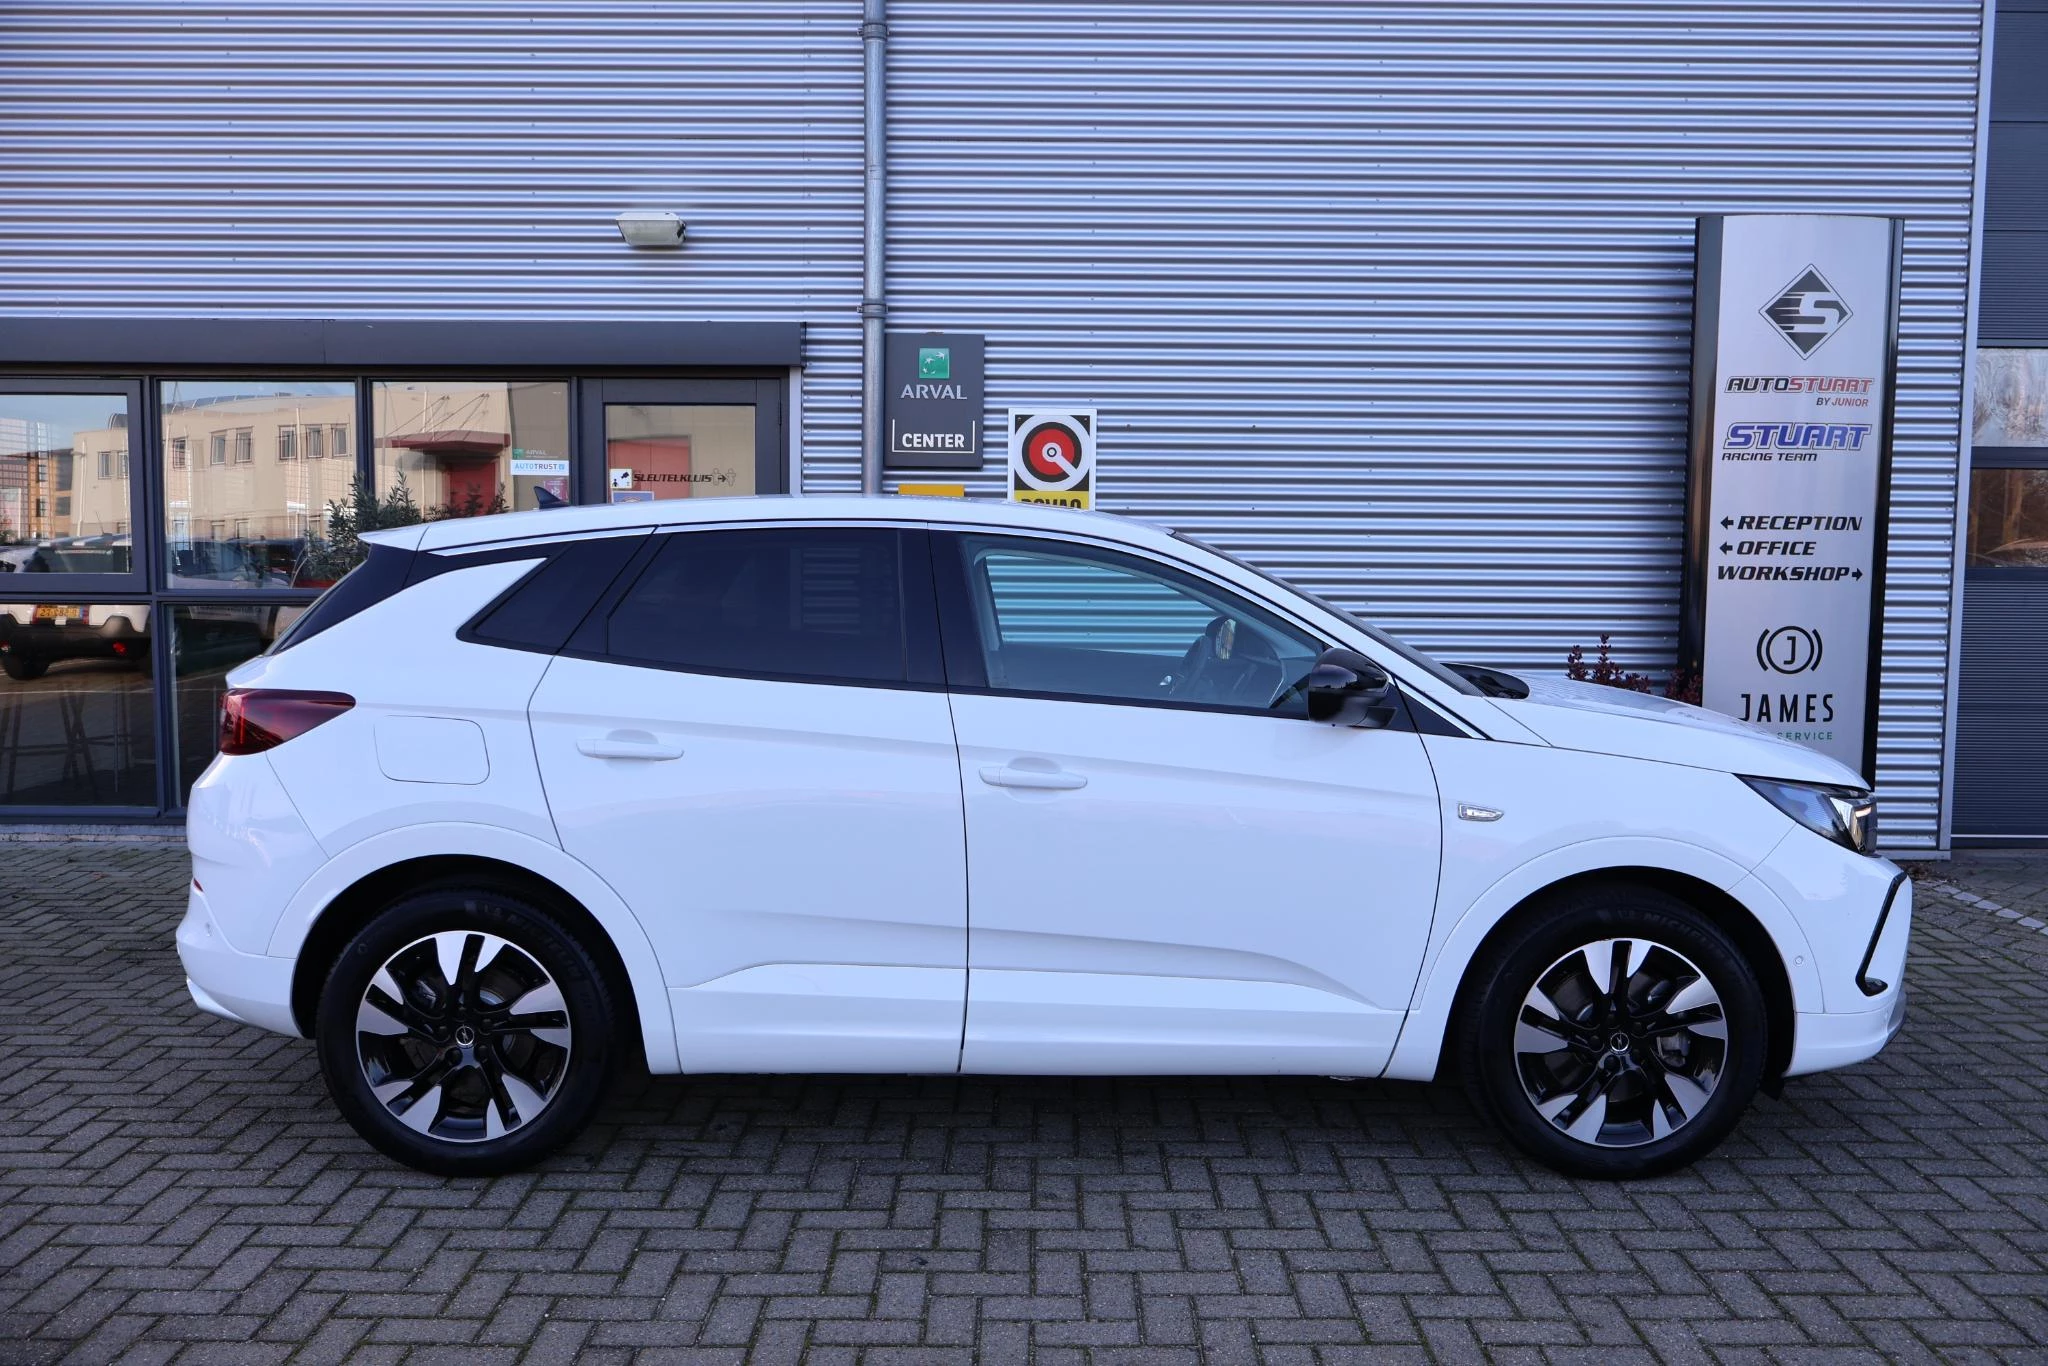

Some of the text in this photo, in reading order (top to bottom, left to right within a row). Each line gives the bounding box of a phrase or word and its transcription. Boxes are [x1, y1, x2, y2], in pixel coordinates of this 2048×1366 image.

[900, 384, 968, 400] ARVAL
[1725, 376, 1873, 393] AUTOSTUART
[1816, 397, 1869, 407] BY JUNIOR
[902, 433, 965, 448] CENTER
[1724, 422, 1872, 450] STUART
[1721, 452, 1818, 461] RACING TEAM
[633, 473, 712, 483] SLEUTELKLUIS
[1737, 516, 1862, 531] RECEPTION
[1736, 541, 1817, 556] OFFICE
[1717, 566, 1850, 581] WORKSHOP
[1738, 693, 1834, 722] JAMES
